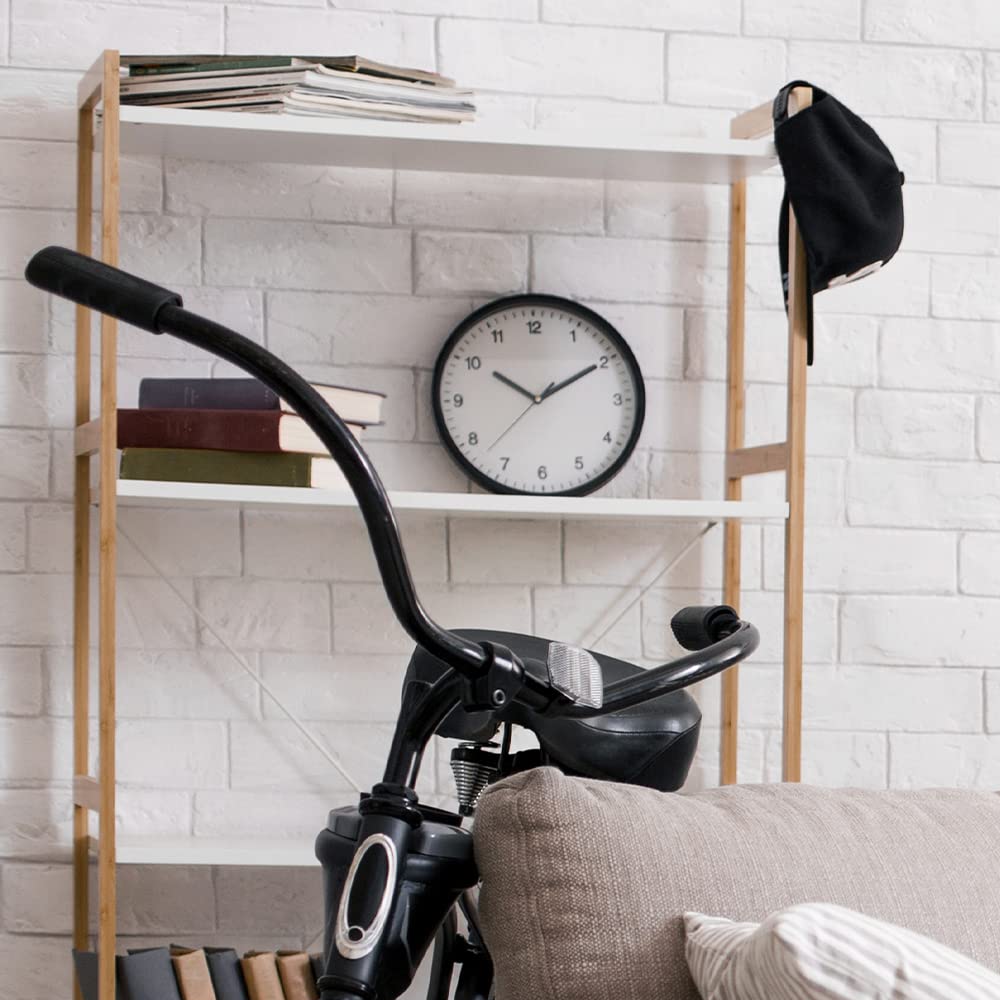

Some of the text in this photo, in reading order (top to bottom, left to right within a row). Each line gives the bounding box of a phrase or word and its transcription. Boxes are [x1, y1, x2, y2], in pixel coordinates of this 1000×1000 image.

[527, 320, 542, 335] 12
[491, 330, 503, 343] 11
[570, 330, 577, 342] 1
[465, 356, 482, 370] 10
[599, 356, 609, 369] 2
[453, 394, 464, 408] 9
[613, 393, 623, 406] 3
[468, 432, 478, 445] 8
[602, 431, 612, 443] 4
[500, 457, 510, 471] 7
[574, 456, 584, 470] 5
[537, 466, 547, 479] 6
